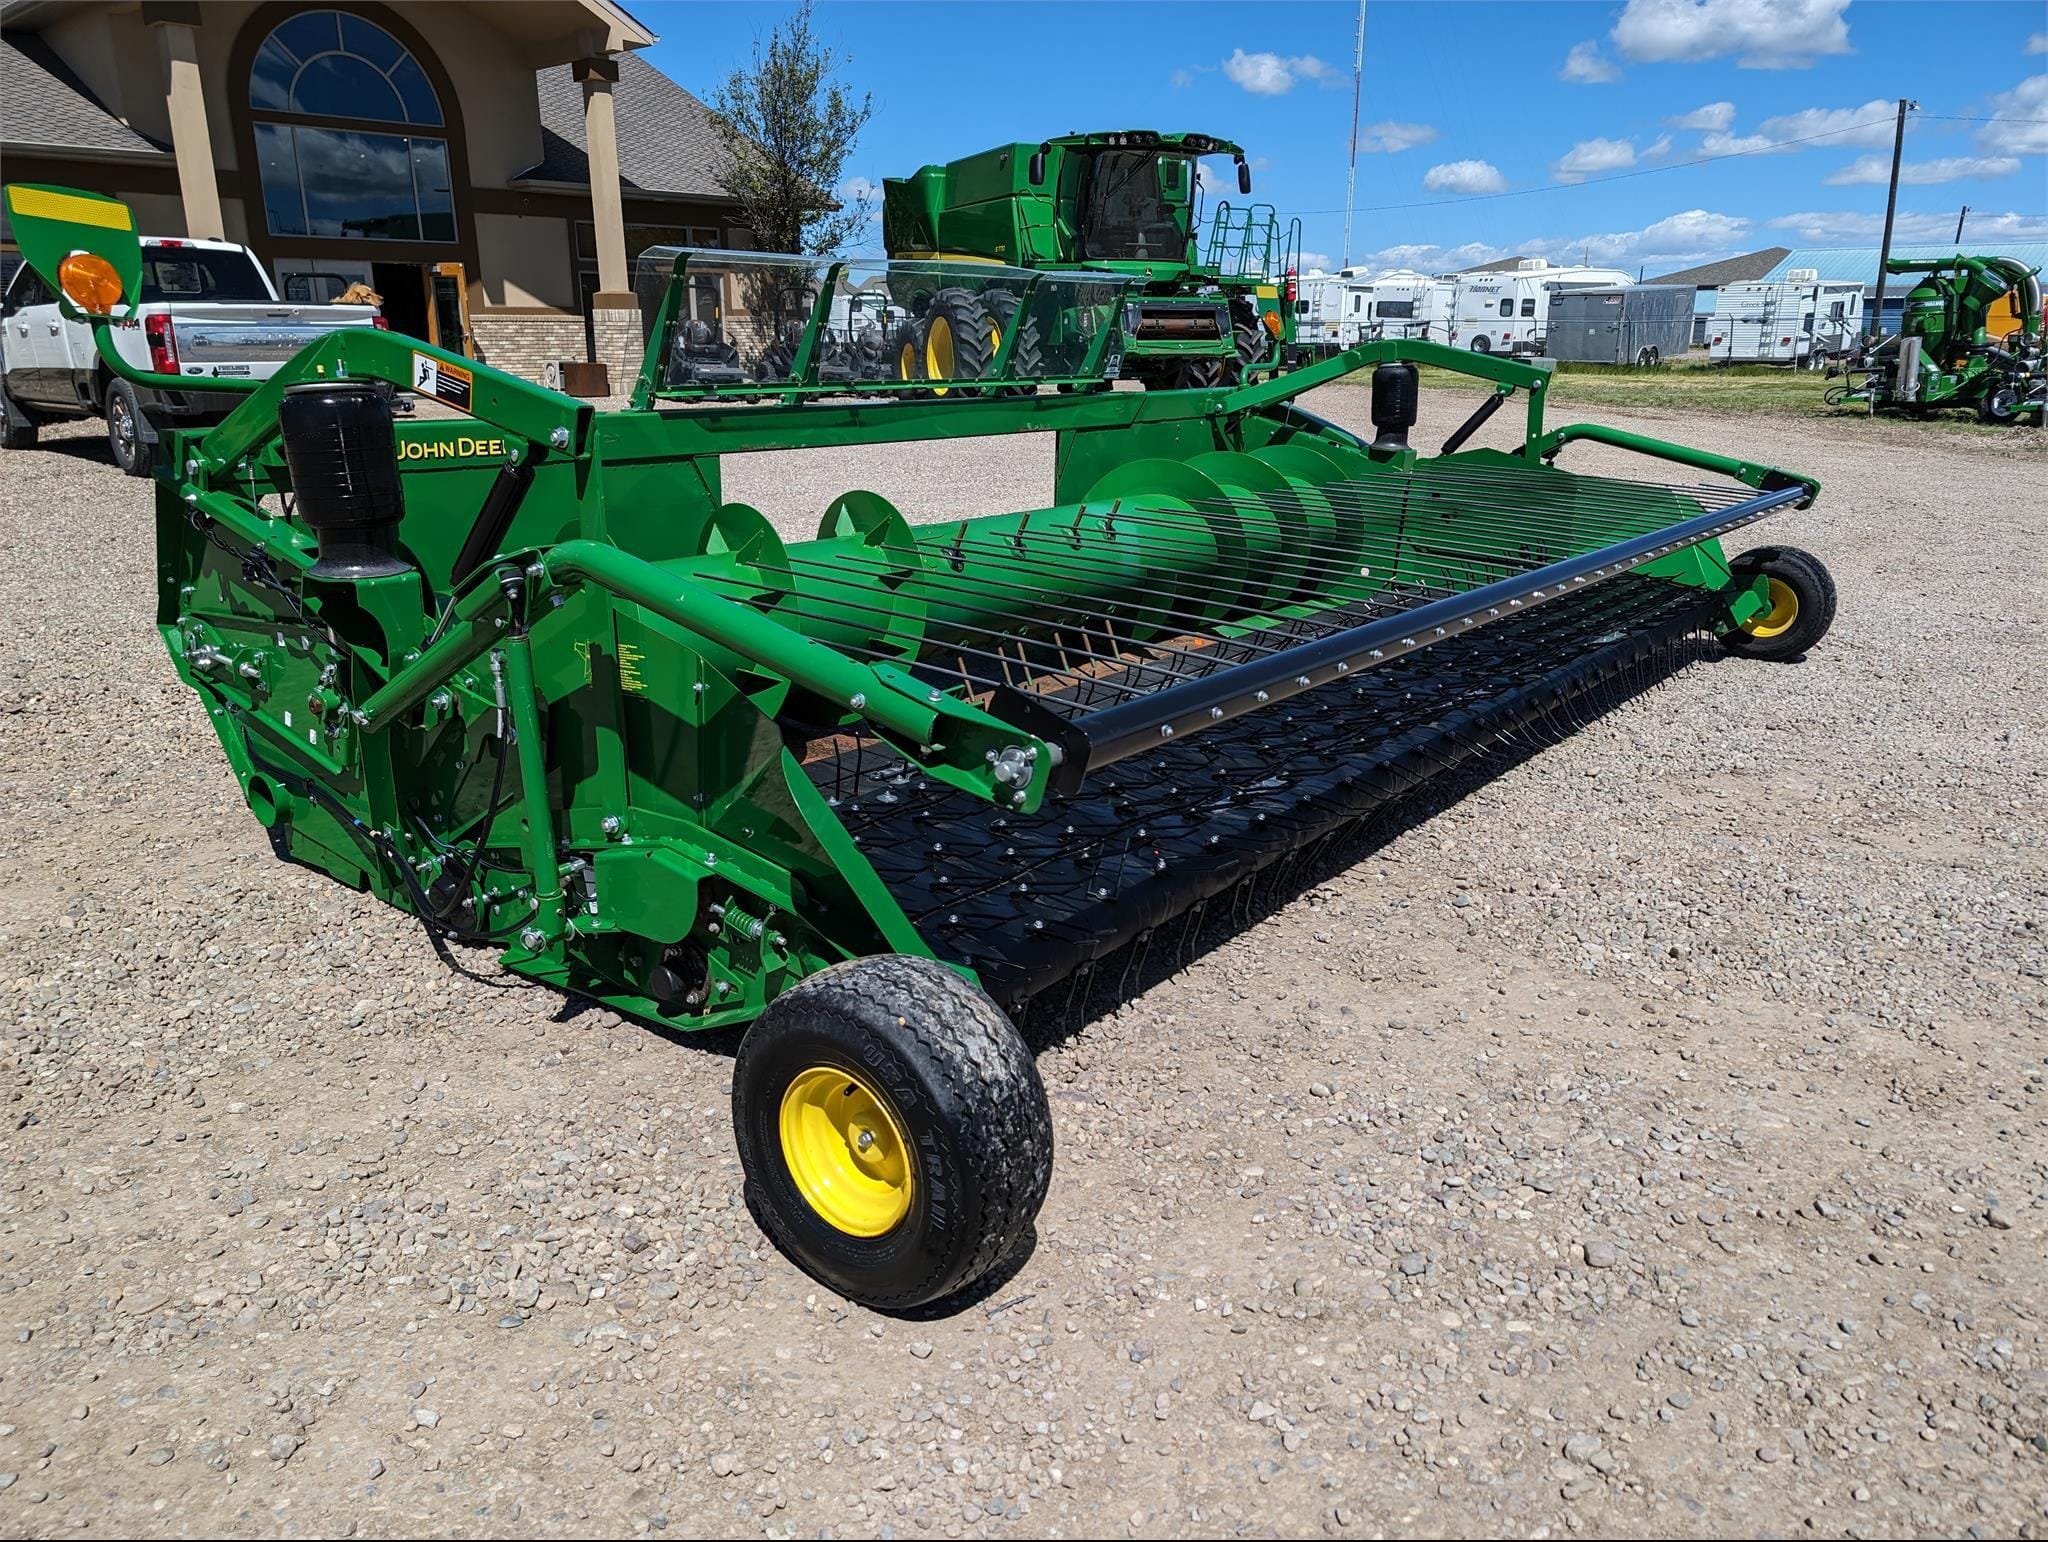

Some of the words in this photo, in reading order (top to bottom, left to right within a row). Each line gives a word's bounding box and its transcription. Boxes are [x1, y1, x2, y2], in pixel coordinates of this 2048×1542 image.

[445, 366, 471, 382] WARNING
[397, 440, 455, 461] JOHN
[457, 437, 507, 457] DEE
[919, 1129, 947, 1232] TRAIL
